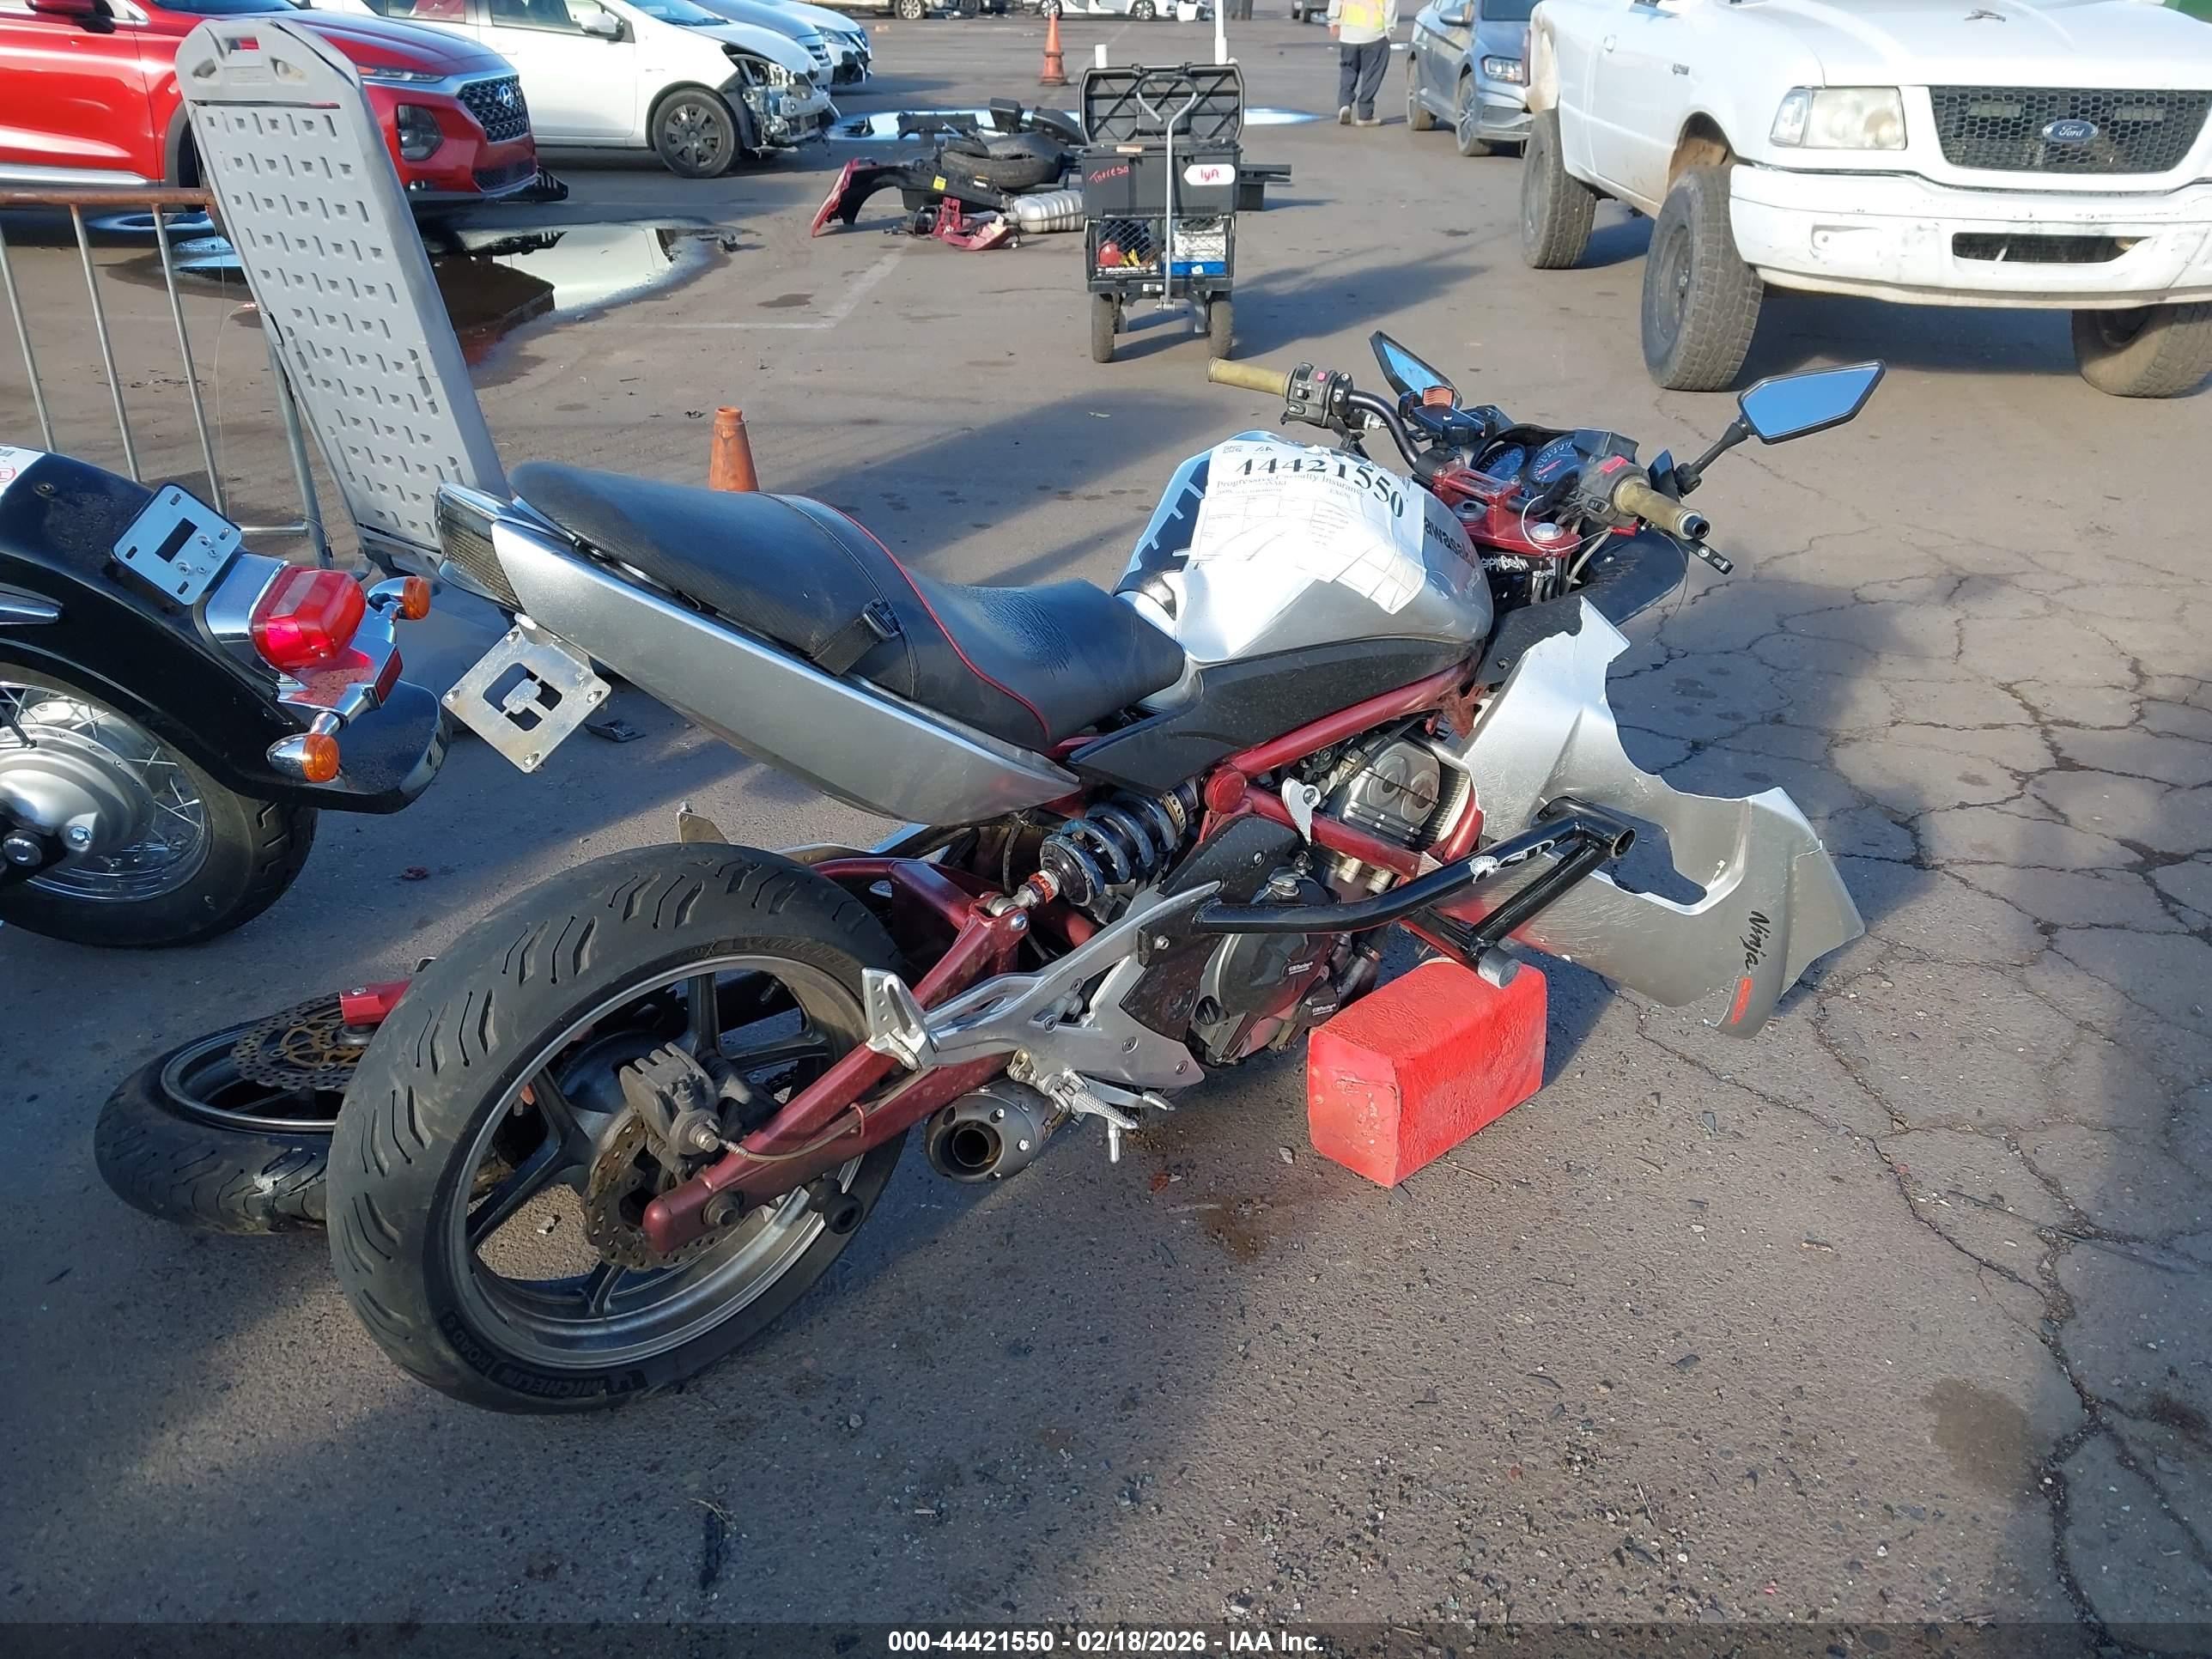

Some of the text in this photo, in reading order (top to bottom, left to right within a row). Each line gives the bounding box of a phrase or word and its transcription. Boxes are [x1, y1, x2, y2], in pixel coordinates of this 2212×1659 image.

[2058, 125, 2085, 137] Ford
[1739, 910, 1771, 970] Ninja
[454, 1330, 492, 1370] ROAD
[500, 1369, 605, 1397] MICHELIN
